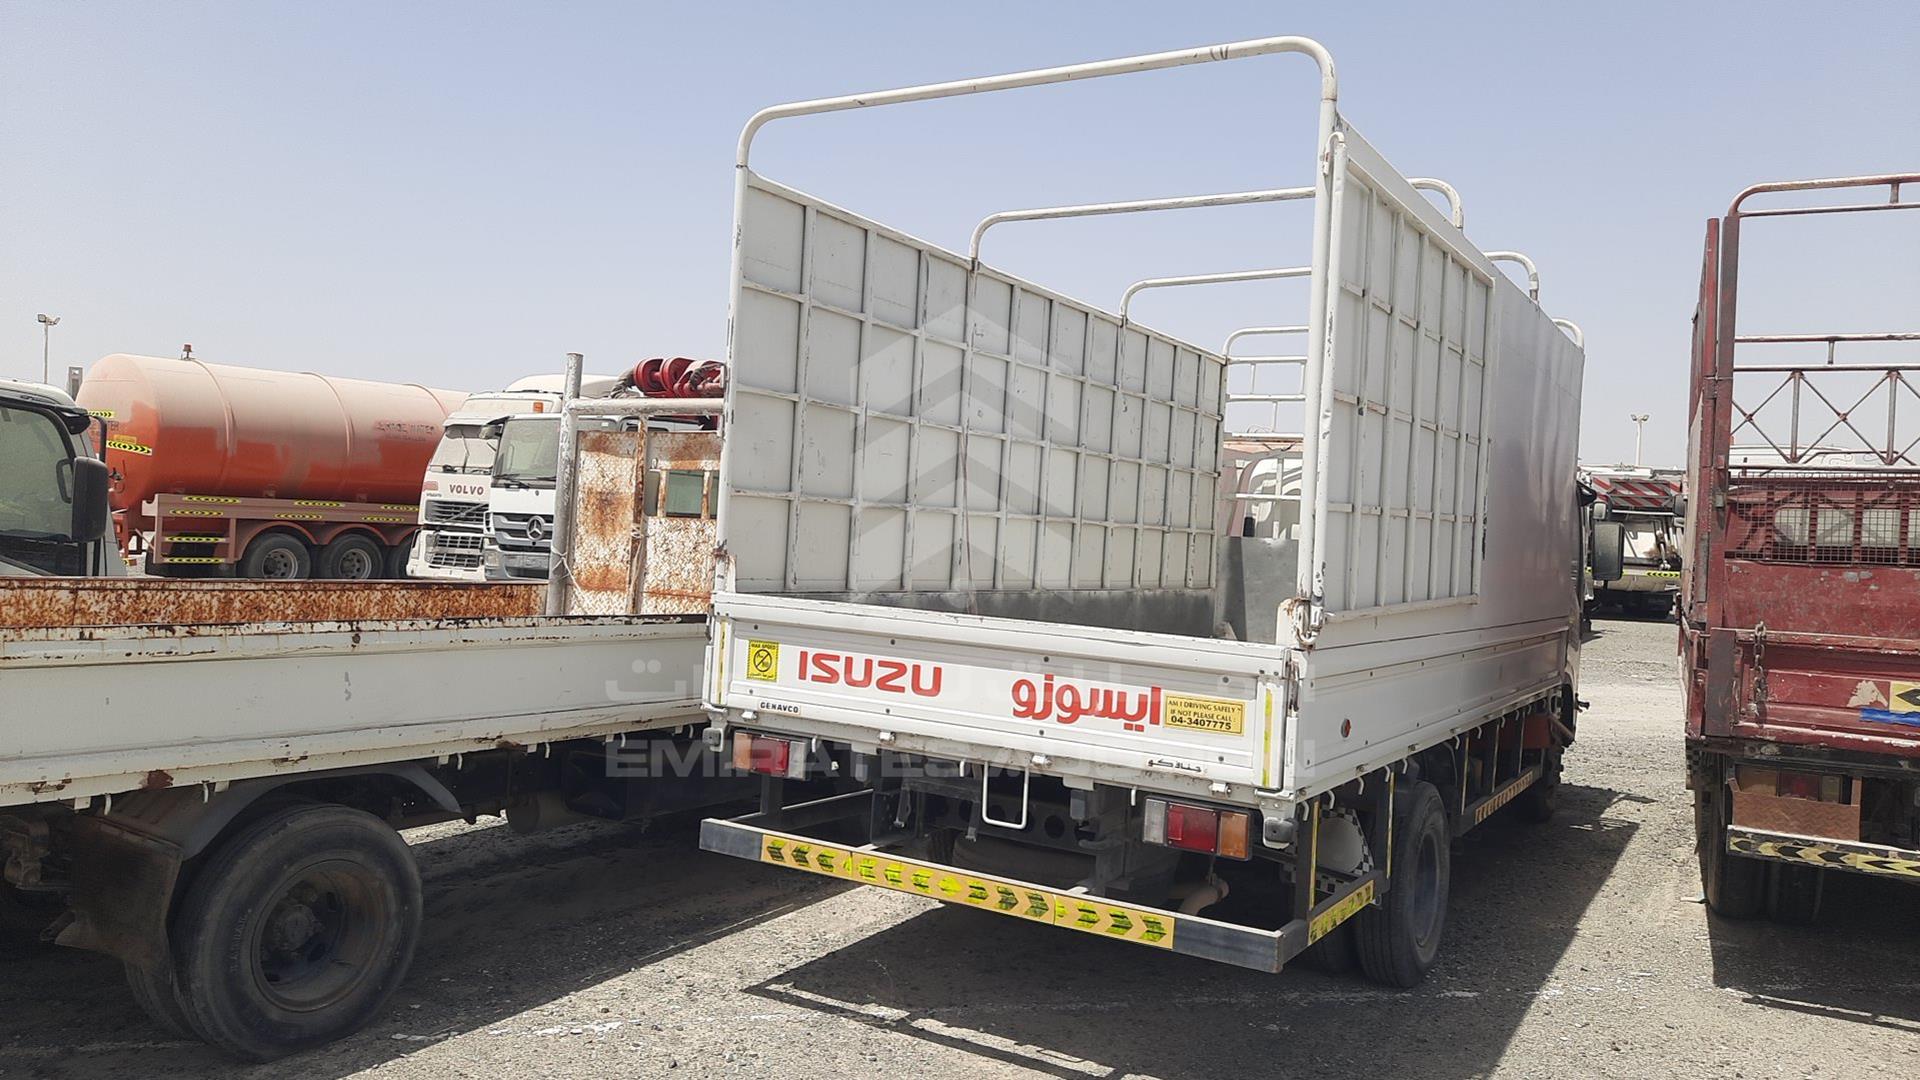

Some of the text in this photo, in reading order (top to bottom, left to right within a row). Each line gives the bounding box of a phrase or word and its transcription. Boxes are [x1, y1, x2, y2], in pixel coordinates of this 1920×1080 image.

[449, 484, 485, 496] VOLVO
[798, 650, 943, 697] ISUZU
[760, 702, 799, 714] GENAVCO
[1011, 673, 1162, 732] ايسوزو
[1184, 702, 1212, 710] DRIVING
[1213, 704, 1236, 713] SAFELY
[1177, 709, 1192, 717] NOT
[1193, 711, 1214, 719] PLEASE
[1216, 714, 1232, 722] CALL
[1170, 715, 1232, 730] 04-3407775
